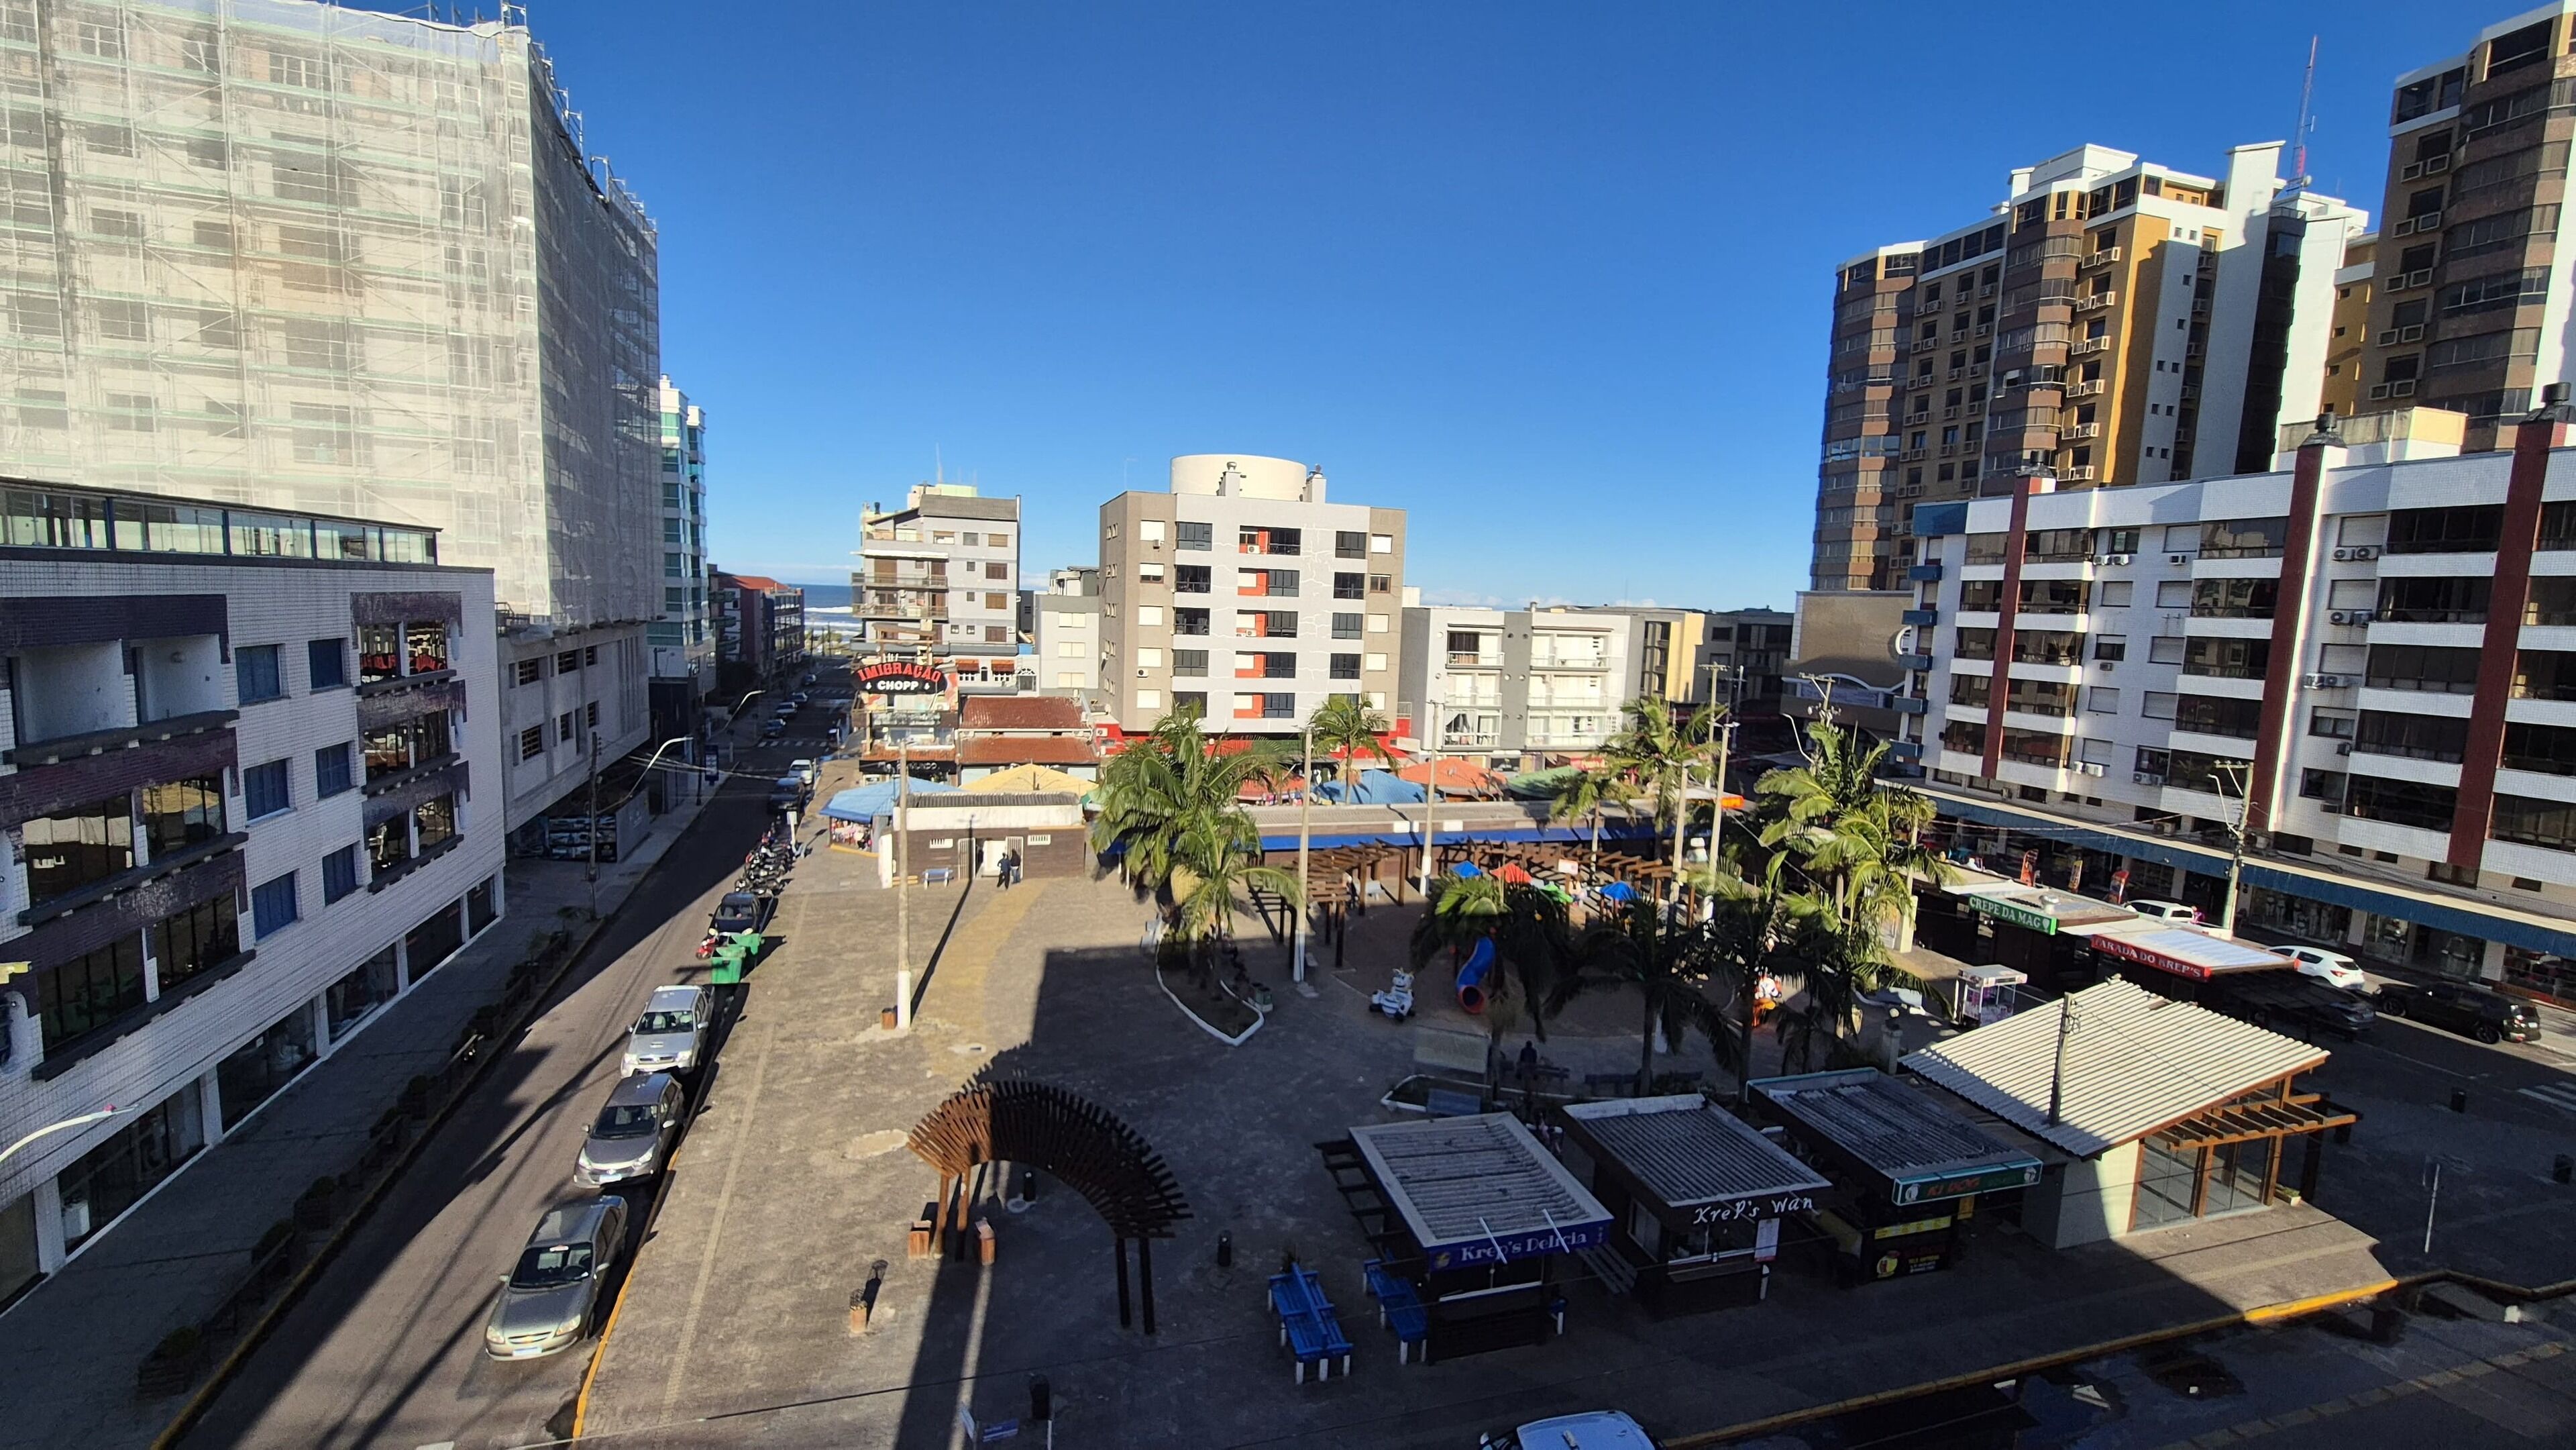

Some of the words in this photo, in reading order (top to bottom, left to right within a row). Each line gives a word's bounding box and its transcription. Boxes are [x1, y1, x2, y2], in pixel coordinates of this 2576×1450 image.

[877, 680, 919, 690] CHOPP
[1969, 897, 2000, 916] CREPE
[2002, 907, 2016, 921] DA
[2018, 911, 2041, 929] MAG
[2095, 937, 2138, 959] PARADA
[2140, 951, 2155, 964] DO
[2158, 958, 2201, 978] KREP'S
